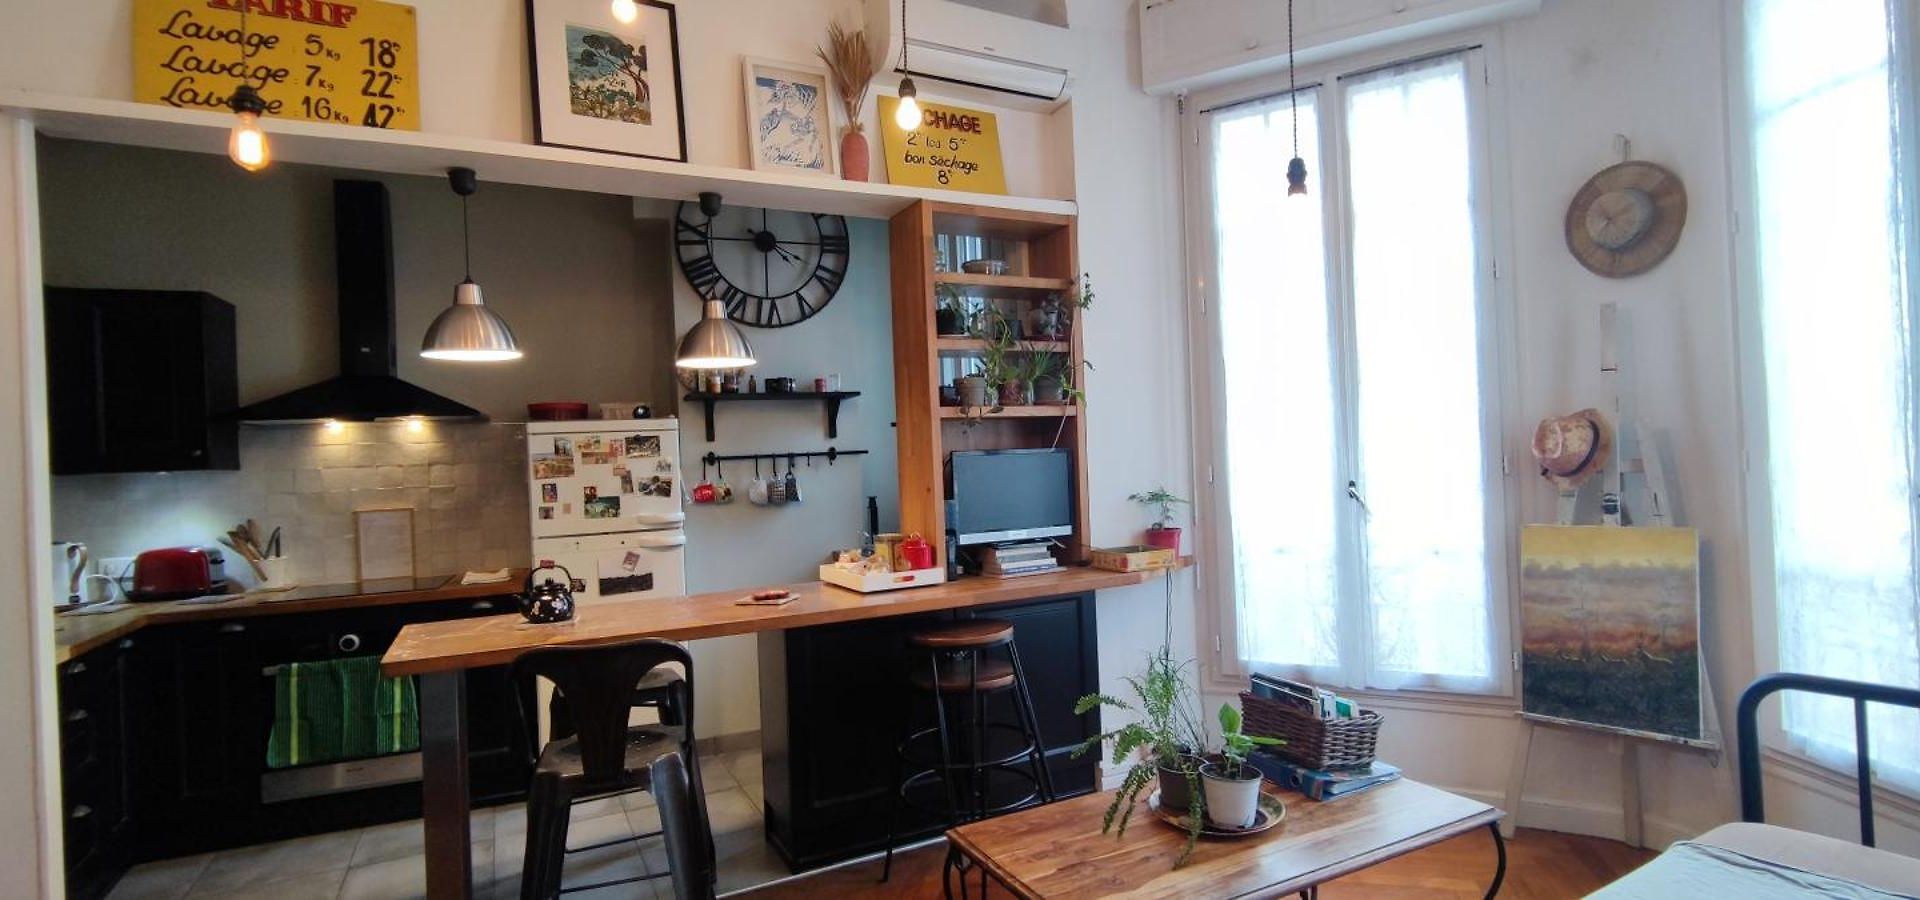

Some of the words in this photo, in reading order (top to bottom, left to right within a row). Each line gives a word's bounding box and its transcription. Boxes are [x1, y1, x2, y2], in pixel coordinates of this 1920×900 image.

[158, 10, 279, 57] Lavage
[161, 45, 289, 90] Lavage
[161, 77, 282, 114] Lave
[923, 108, 982, 135] CHAGE
[904, 150, 925, 164] bon
